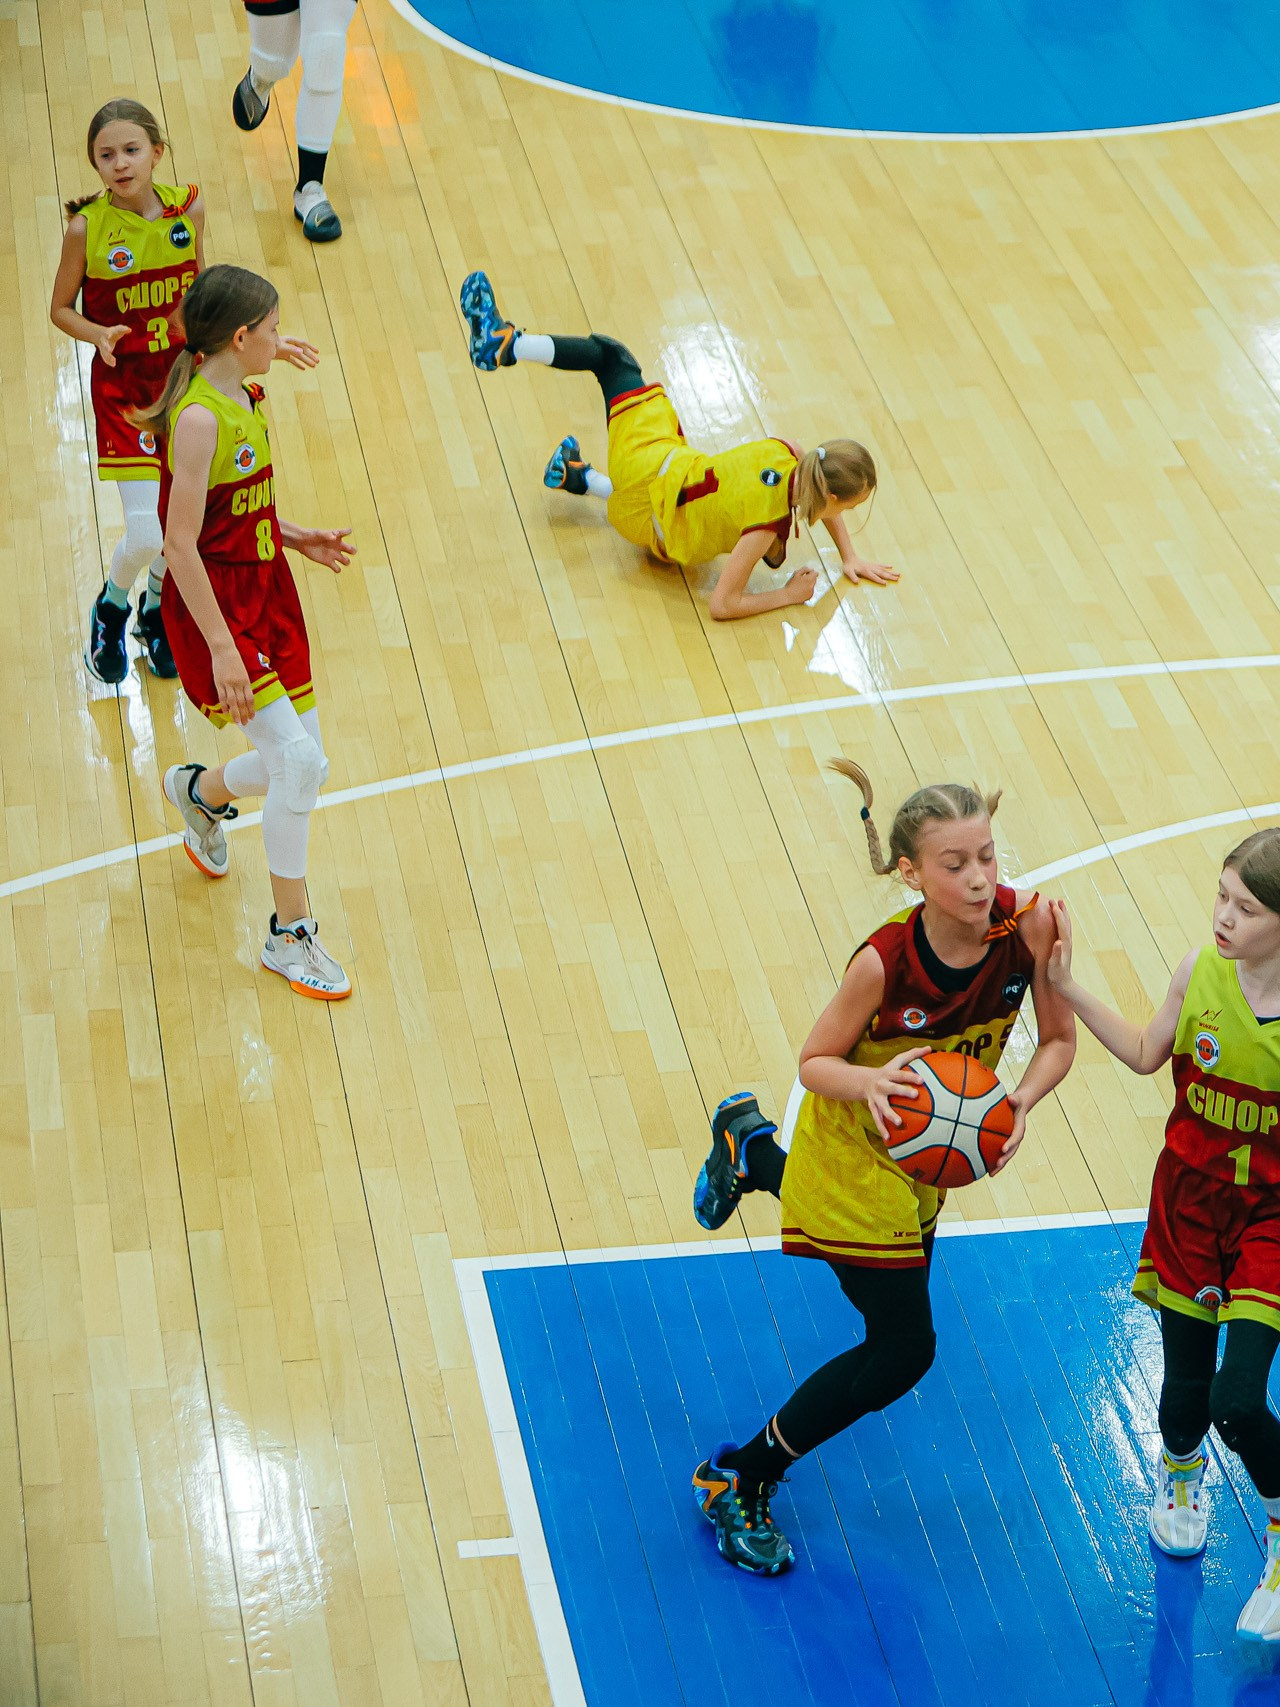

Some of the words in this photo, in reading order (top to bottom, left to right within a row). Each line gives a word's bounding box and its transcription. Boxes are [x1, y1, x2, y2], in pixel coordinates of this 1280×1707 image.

[116, 277, 179, 314] СШОР
[147, 317, 170, 353] 3
[255, 518, 276, 561] 8
[1187, 1082, 1278, 1134] СШОР
[1228, 1145, 1251, 1185] 1
